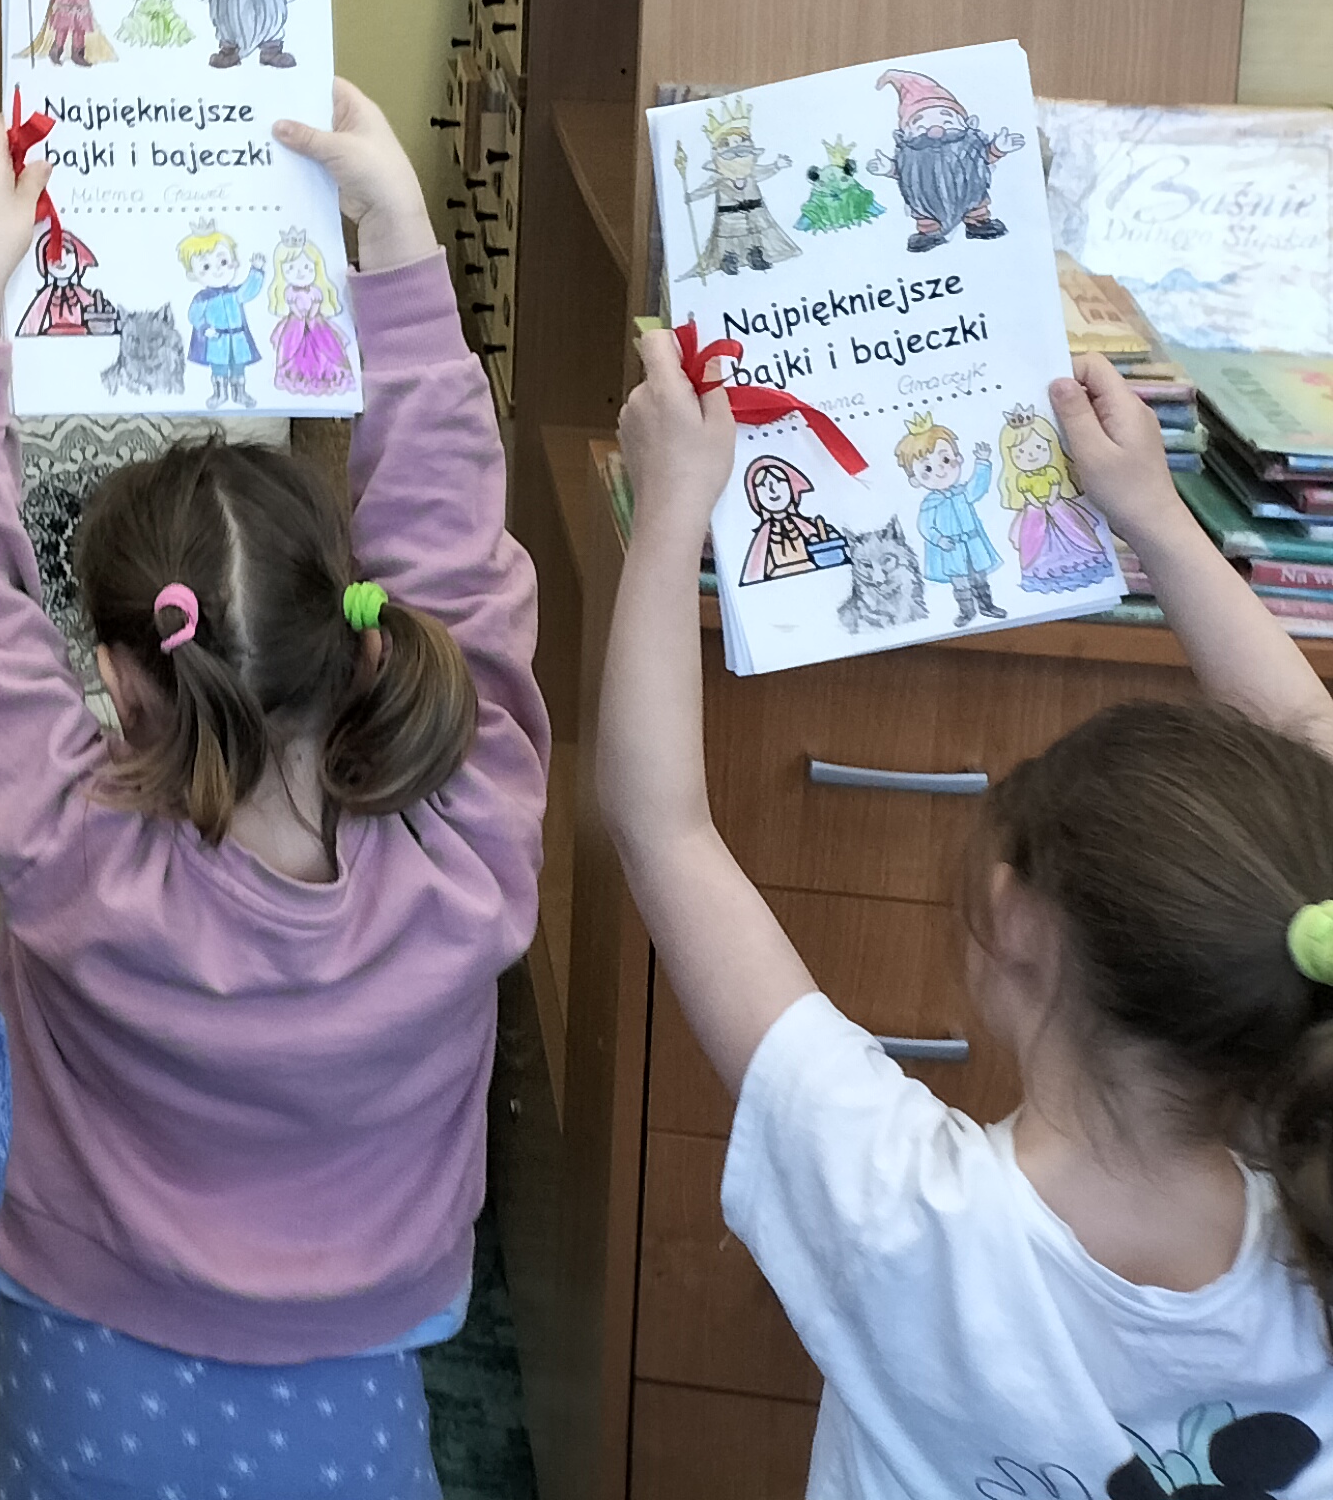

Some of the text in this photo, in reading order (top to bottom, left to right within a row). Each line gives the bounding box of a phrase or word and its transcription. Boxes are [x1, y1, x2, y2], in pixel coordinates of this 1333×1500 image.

[44, 96, 255, 130] Najpiękniejsze
[45, 140, 272, 175] bajki i bajeczki
[1106, 153, 1317, 224] Baśnie
[723, 274, 964, 339] Najpiękniejsze
[732, 312, 989, 390] bajki i bajeczki
